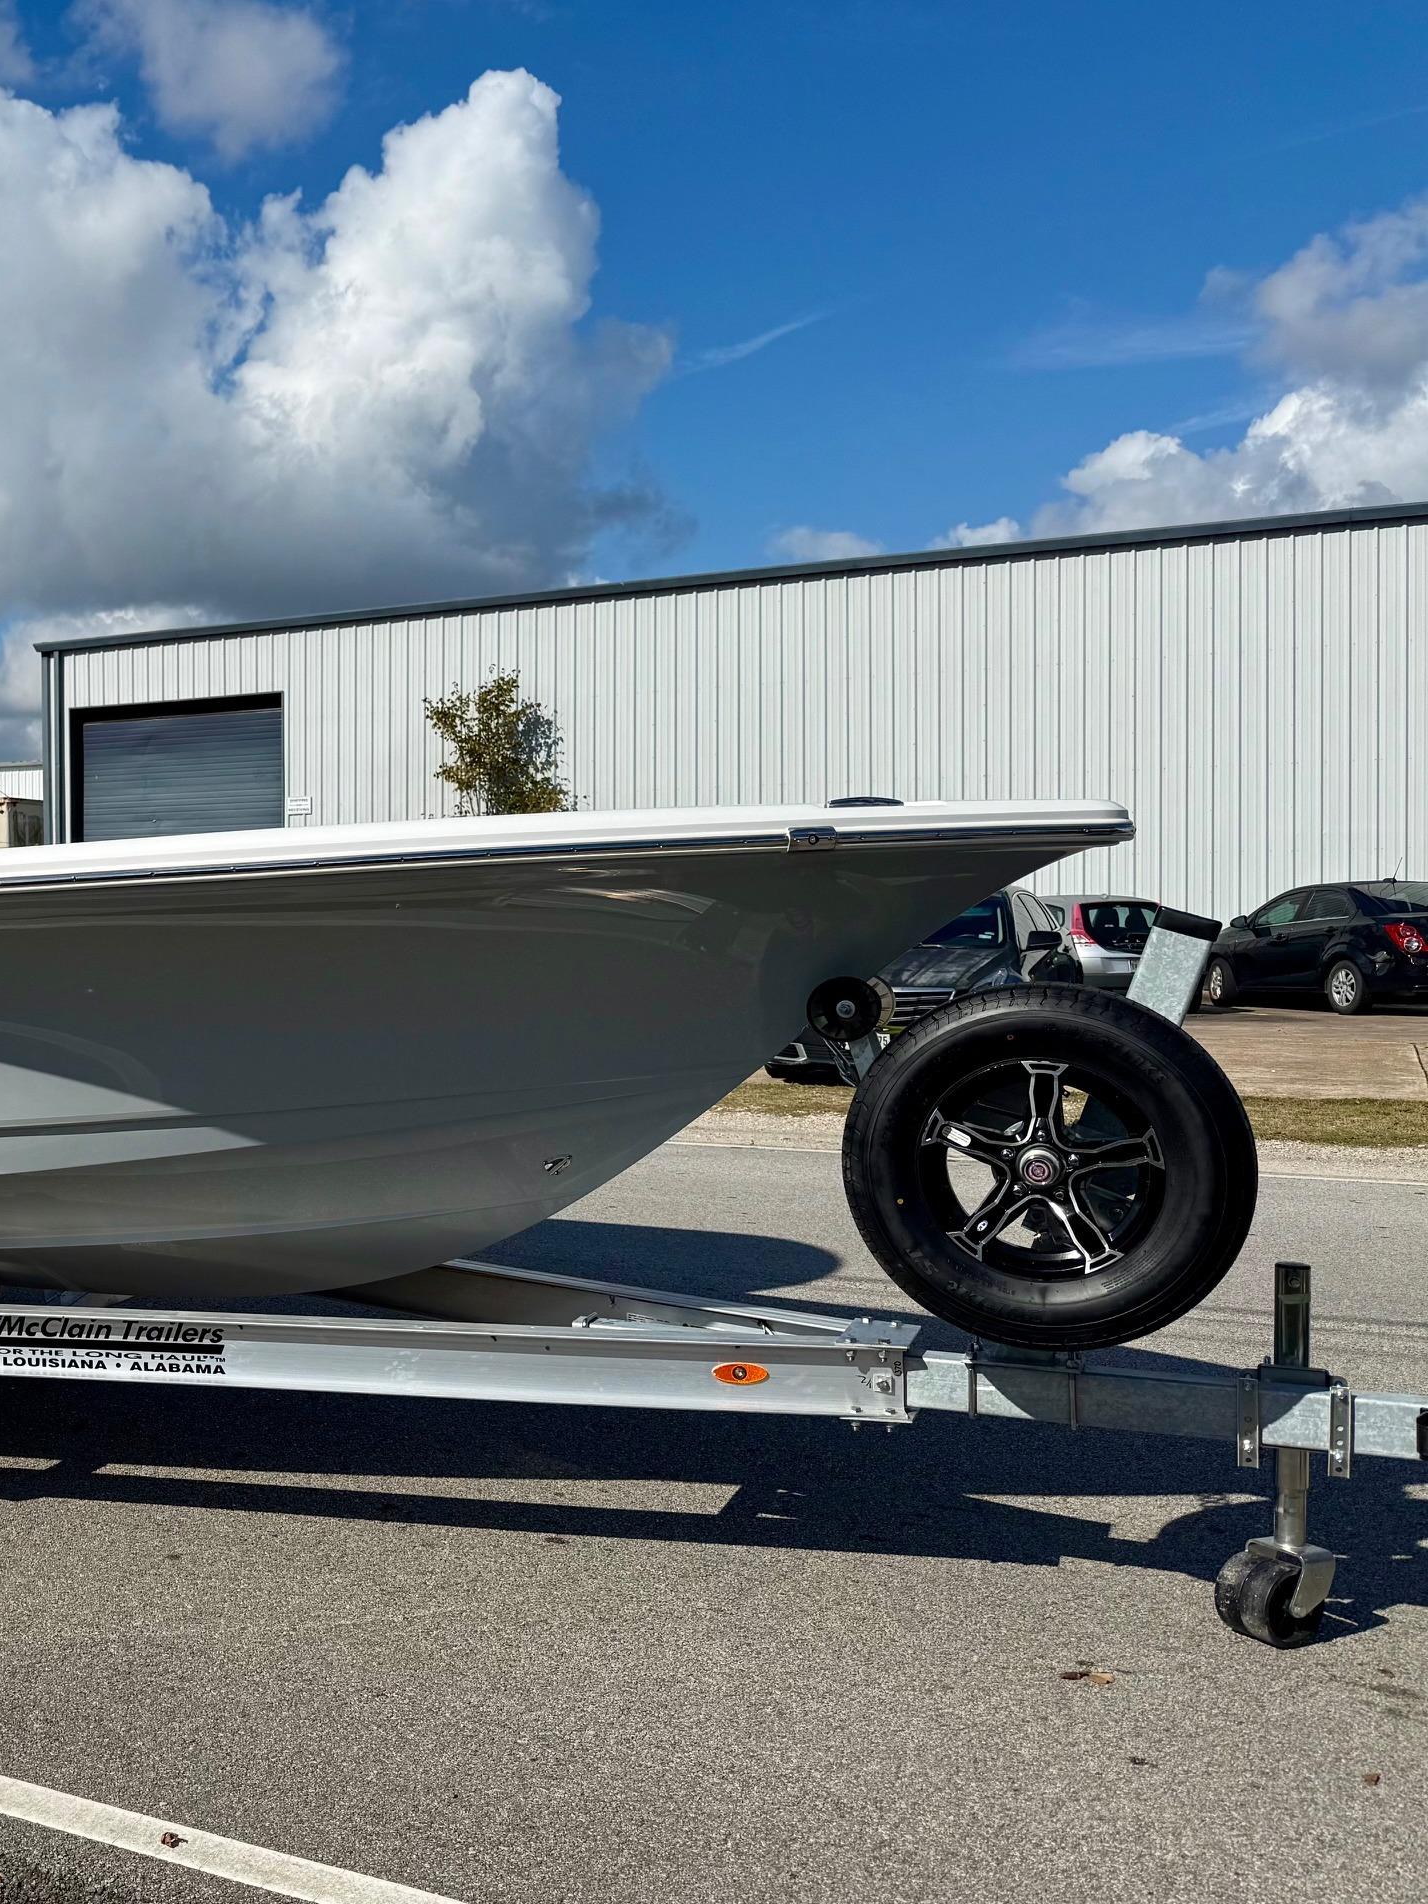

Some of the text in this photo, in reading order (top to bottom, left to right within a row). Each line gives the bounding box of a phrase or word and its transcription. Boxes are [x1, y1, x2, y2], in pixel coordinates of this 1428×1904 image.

[122, 1319, 225, 1343] Trailers
[29, 1348, 64, 1357] THE
[72, 1350, 142, 1360] LONG
[2, 1356, 107, 1369] LOUISIANA
[130, 1361, 226, 1375] ALABAMA
